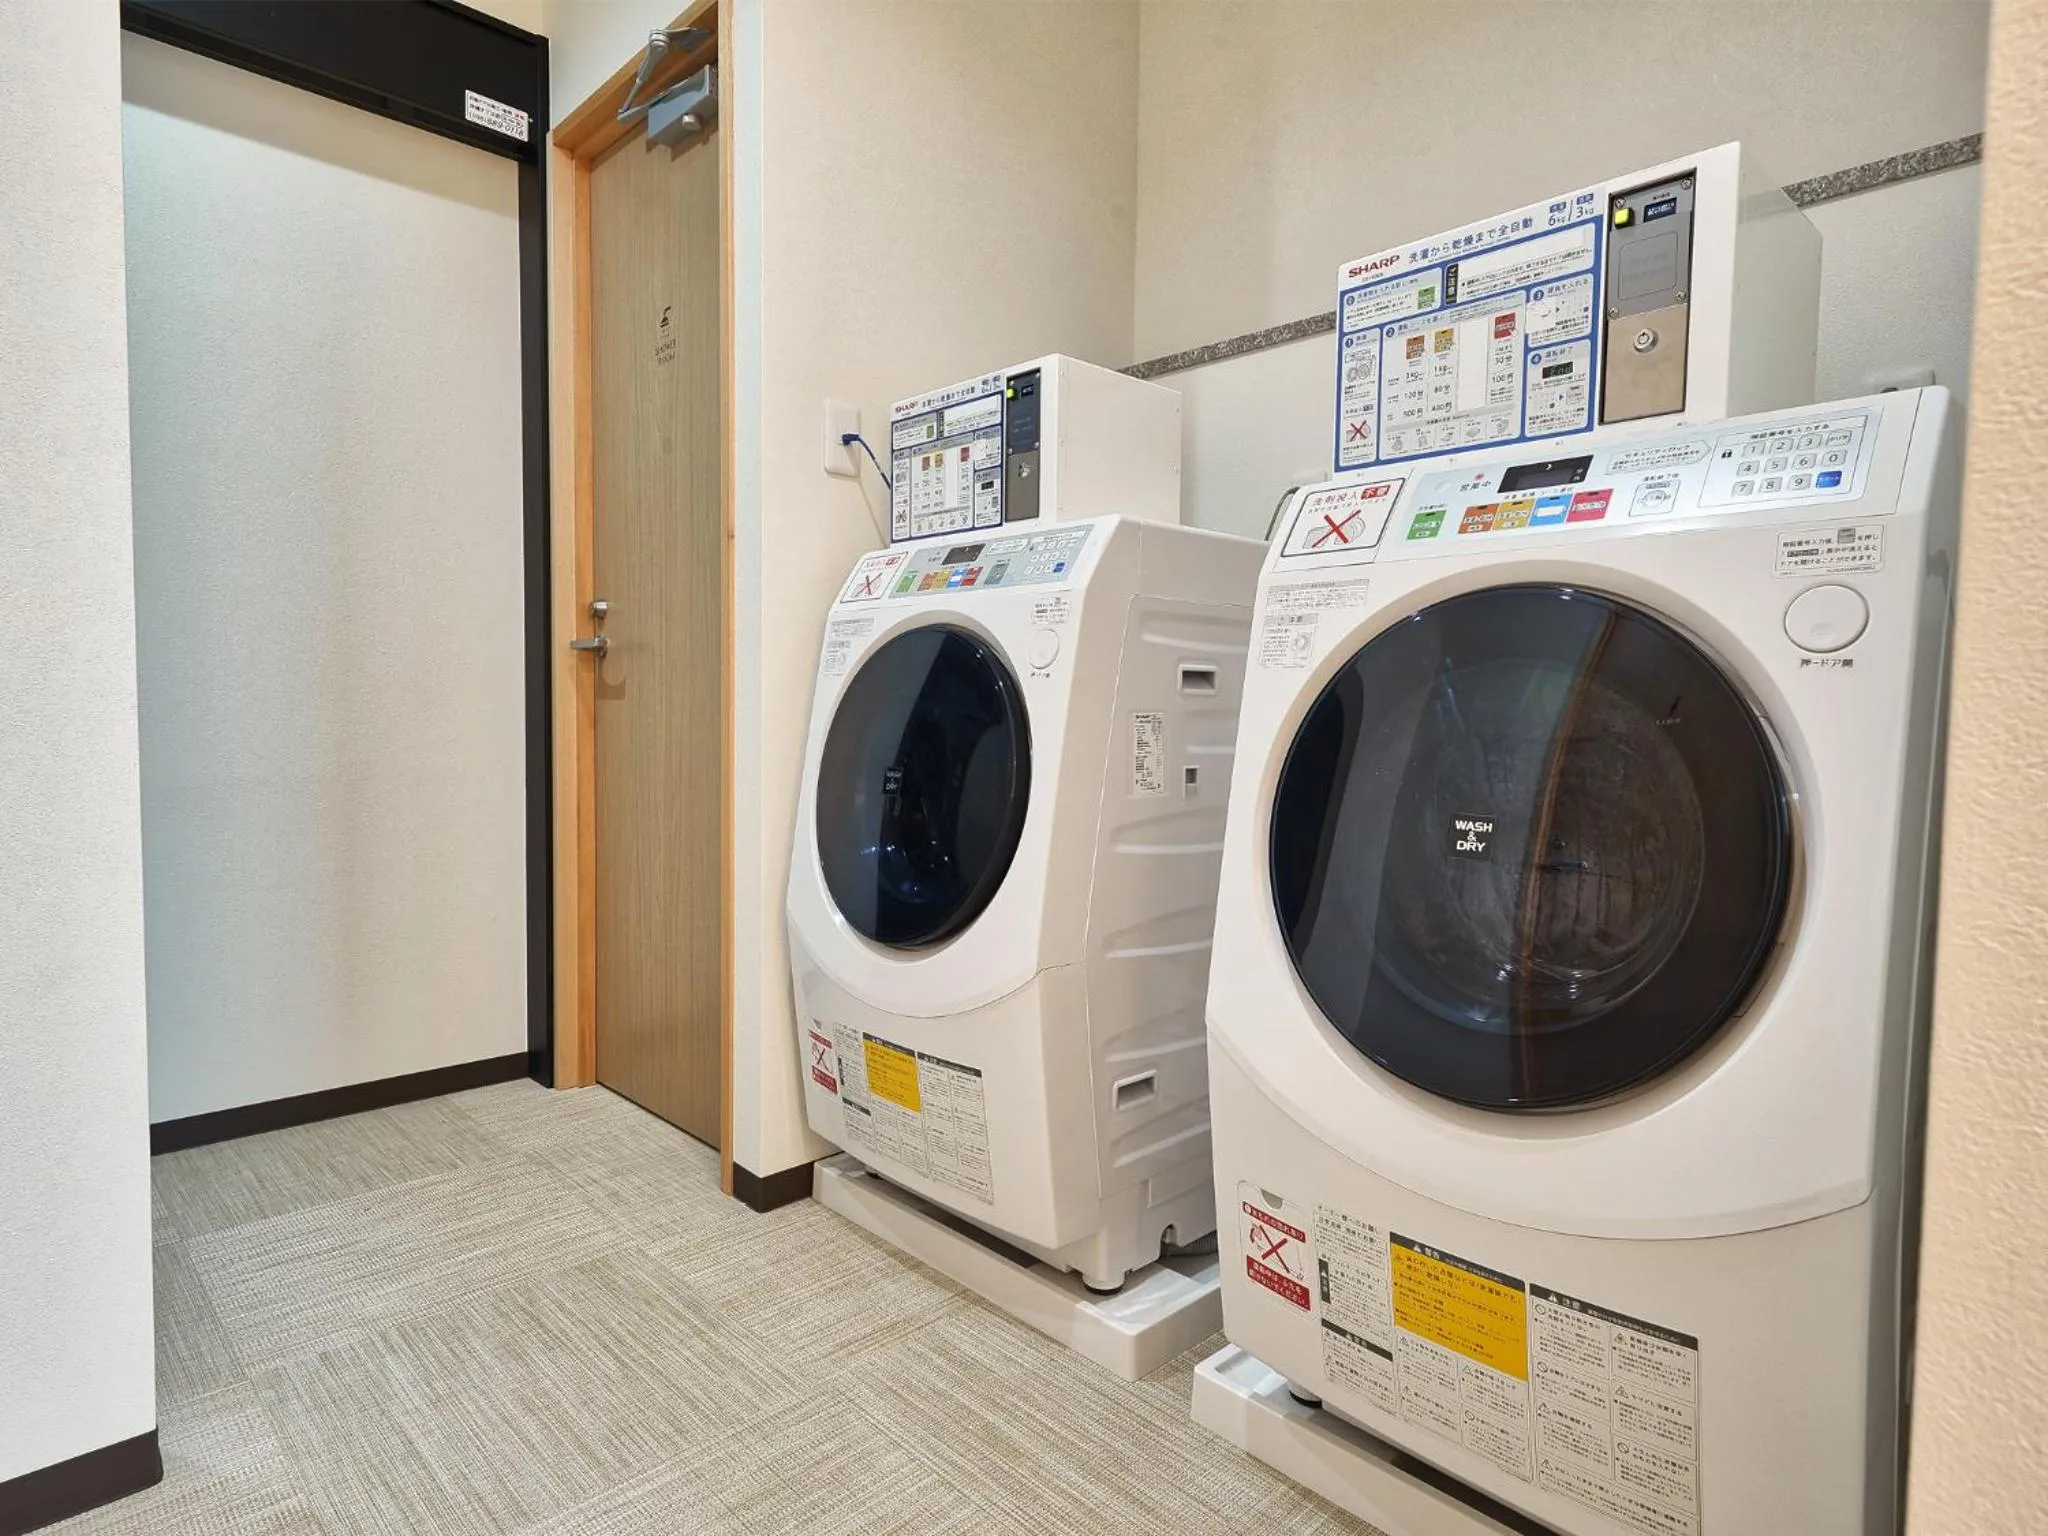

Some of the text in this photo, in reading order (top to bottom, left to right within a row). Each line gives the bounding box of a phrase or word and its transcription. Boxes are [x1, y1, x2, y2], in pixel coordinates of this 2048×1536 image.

[1408, 217, 1534, 266] 洗濯から乾燥まで全自動
[1348, 254, 1400, 278] SHARP
[1776, 441, 1786, 450] 2
[1800, 457, 1808, 466] 6
[1829, 454, 1838, 463] 0
[1766, 480, 1775, 489] 8
[1794, 478, 1803, 486] 9
[1455, 820, 1493, 832] WASH
[1467, 831, 1477, 842] &
[1456, 840, 1486, 852] DRY
